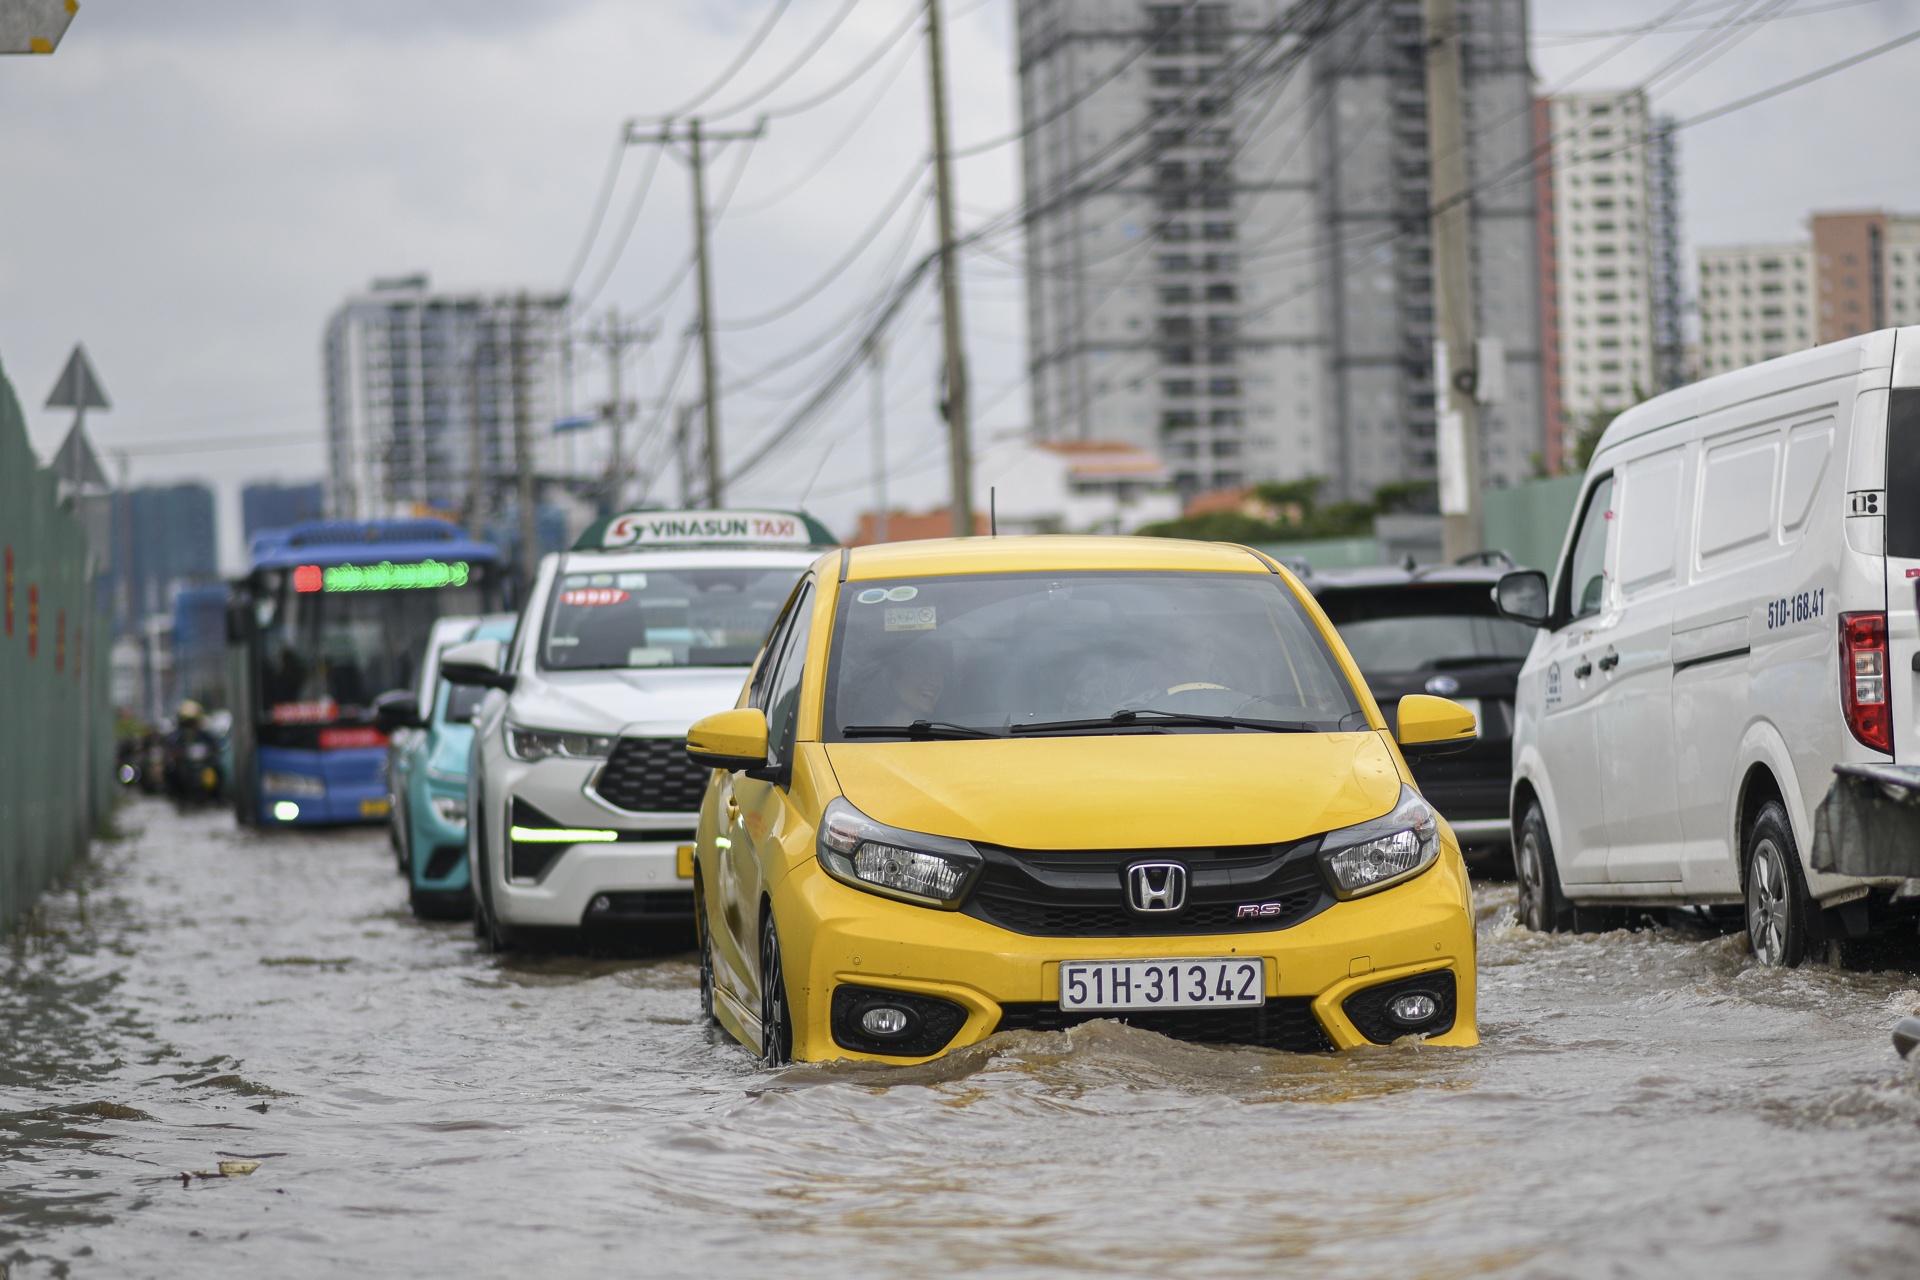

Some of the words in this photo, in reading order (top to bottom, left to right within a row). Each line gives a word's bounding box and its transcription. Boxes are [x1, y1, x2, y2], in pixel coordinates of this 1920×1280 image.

[651, 519, 748, 537] VINASUN
[753, 519, 795, 537] TAXI
[1767, 587, 1824, 630] 51D-168.41
[1237, 902, 1281, 918] RS
[1067, 964, 1257, 1005] 51H-313.42
